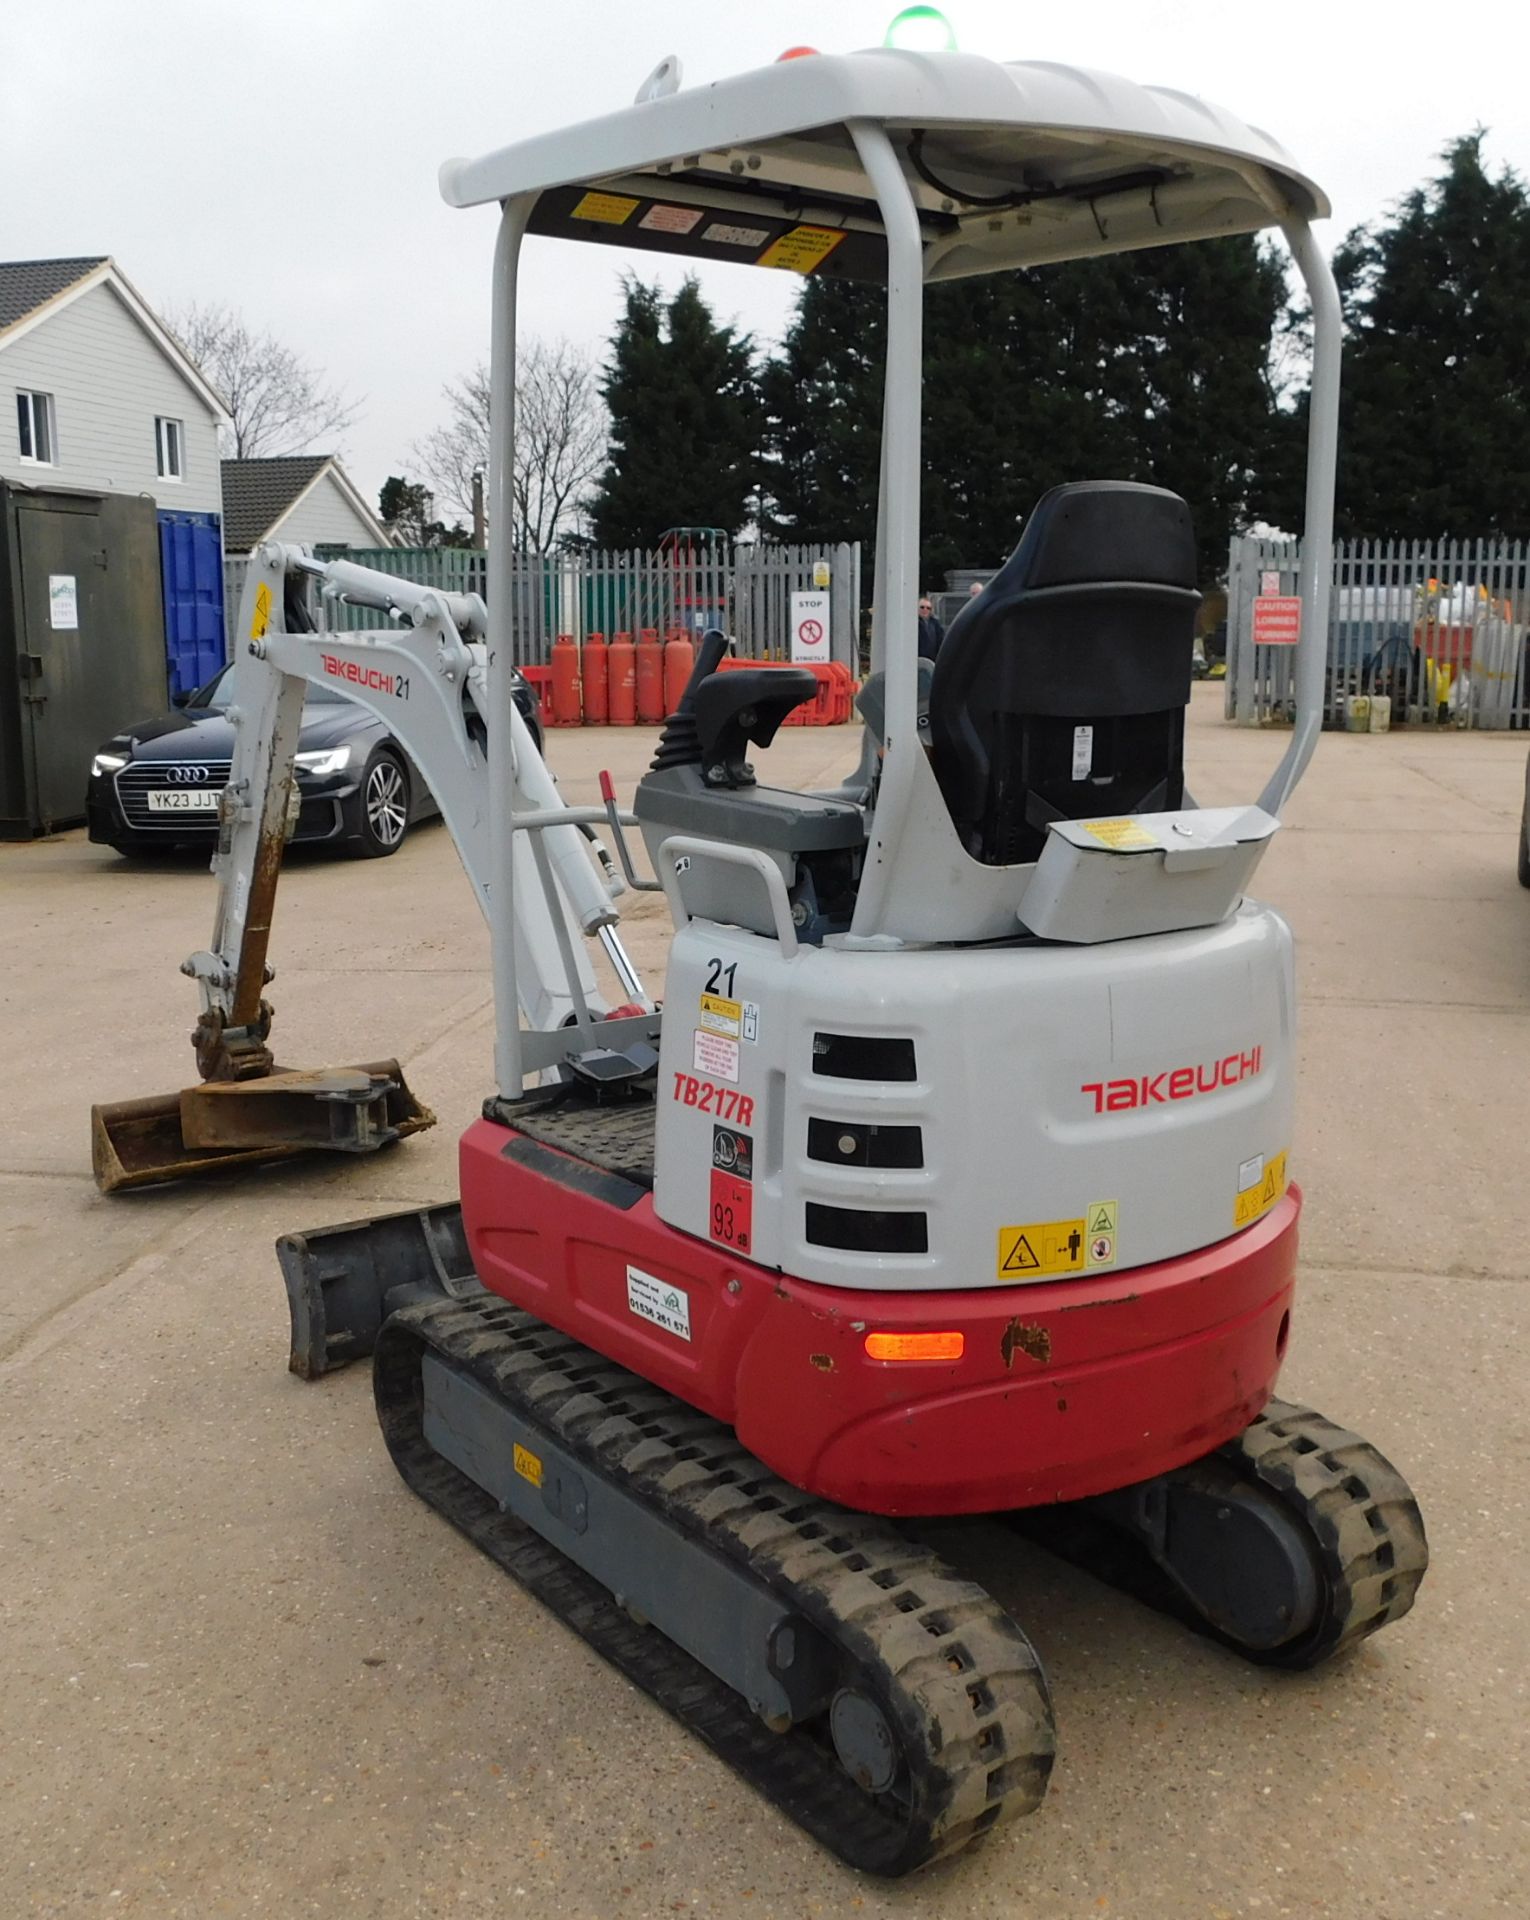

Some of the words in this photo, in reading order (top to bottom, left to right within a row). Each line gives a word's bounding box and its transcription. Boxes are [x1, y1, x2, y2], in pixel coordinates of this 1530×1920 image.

[1256, 602, 1298, 611] CAUTION
[396, 675, 410, 700] 21
[155, 793, 189, 807] YK23
[705, 958, 738, 998] 21
[674, 1072, 754, 1127] TB217R
[714, 1203, 734, 1241] 93
[738, 1232, 748, 1247] dB
